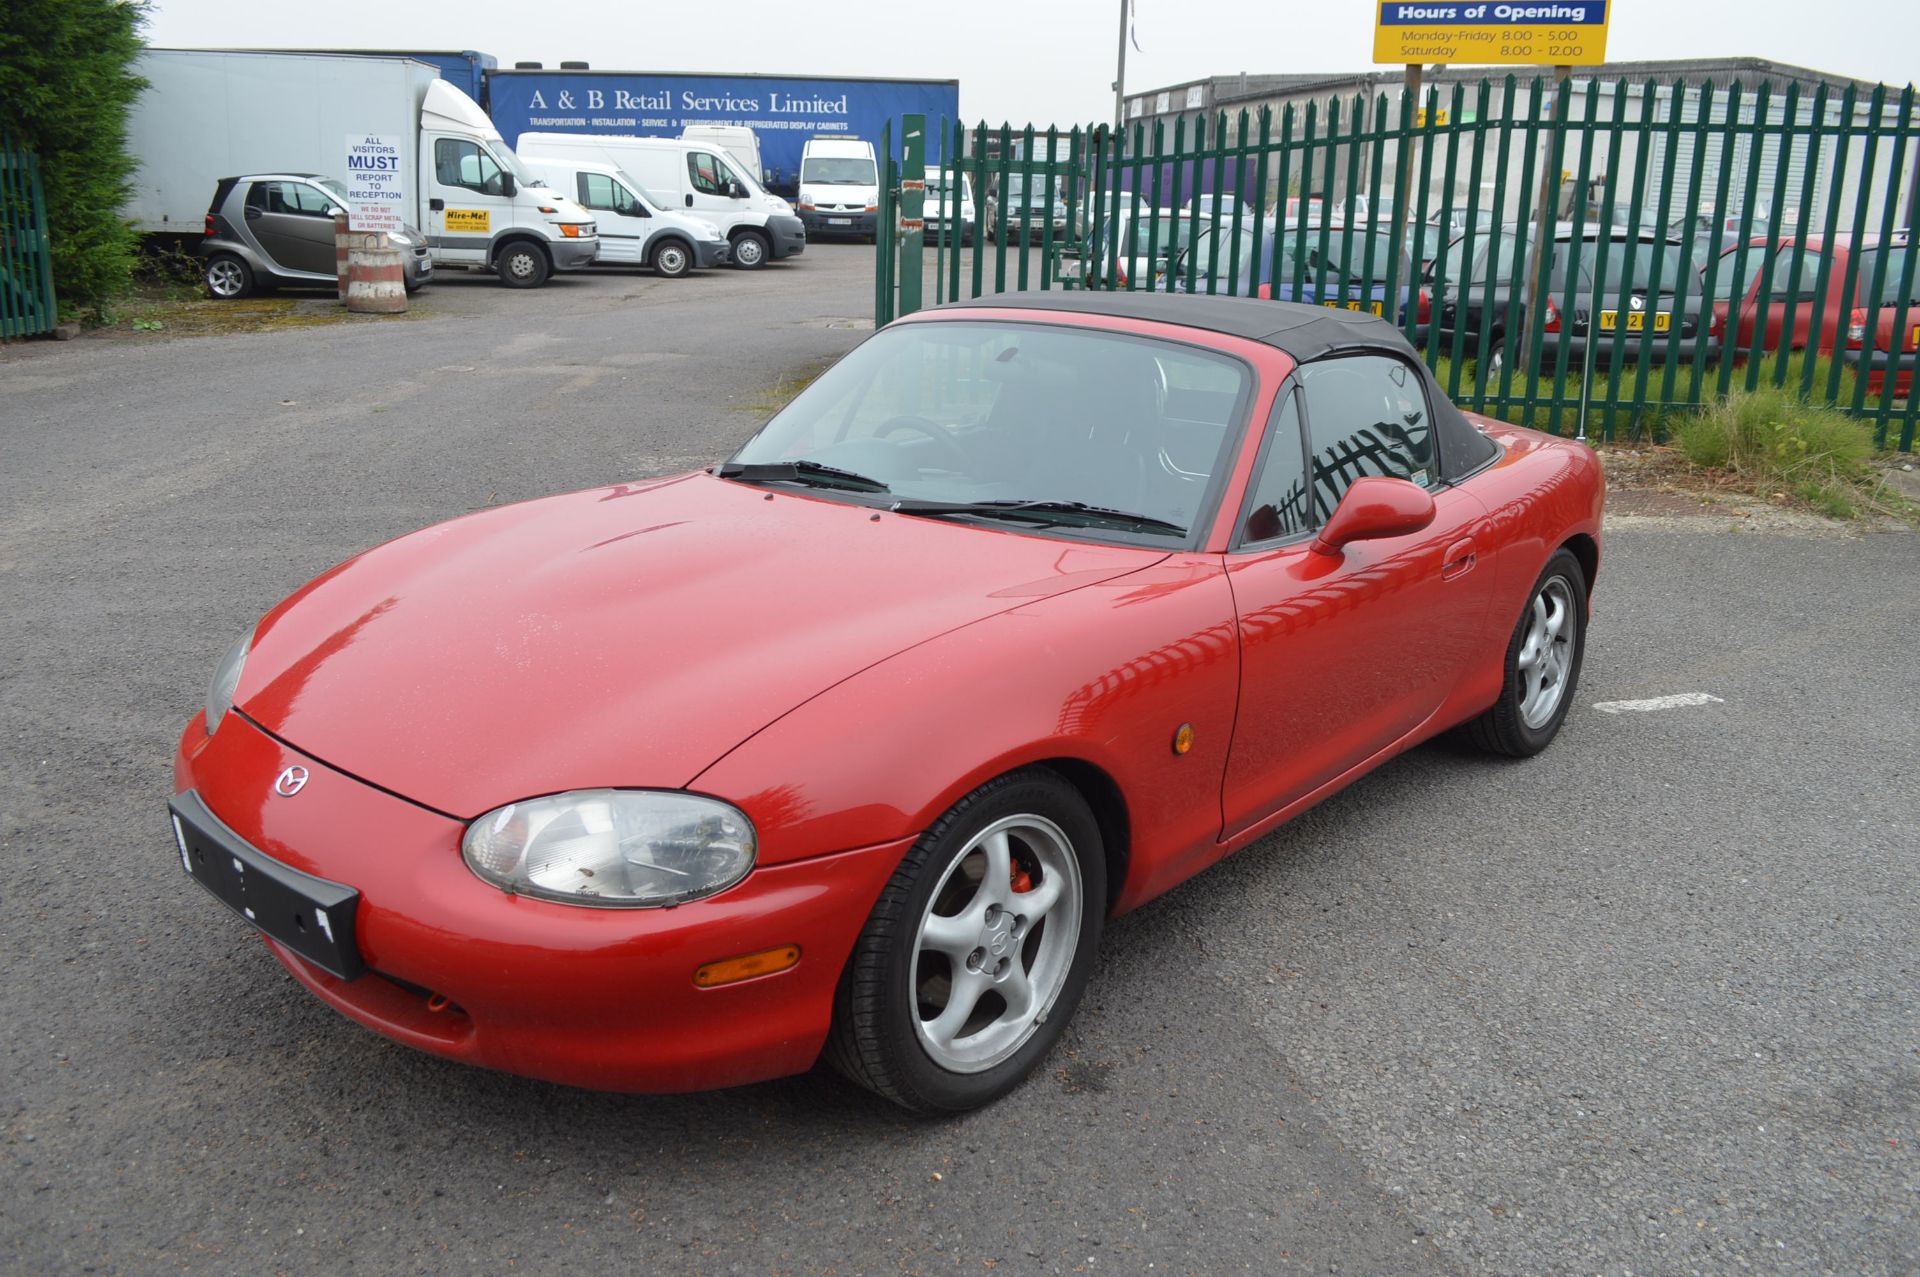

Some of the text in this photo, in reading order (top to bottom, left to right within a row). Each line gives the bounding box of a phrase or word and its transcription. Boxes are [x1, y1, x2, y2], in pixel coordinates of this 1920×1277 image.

[1398, 5, 1586, 22] Hours of Opening
[1401, 31, 1497, 43] Monday-Friday
[1502, 30, 1533, 41] 8.00
[1548, 30, 1578, 41] 5.00
[1401, 45, 1457, 58] Saturday
[1500, 46, 1533, 56] 8.00
[1549, 46, 1583, 57] 12.00
[529, 89, 848, 114] A & B Retail Services Limited
[529, 118, 586, 126] TRANSPORTATION
[592, 118, 636, 127] INSTALLATION
[642, 118, 668, 127] SERVICE
[744, 120, 788, 129] REFRIGERATED
[790, 121, 816, 130] DISPLAY
[817, 121, 849, 130] CABINETS
[365, 137, 382, 145] ALL
[352, 145, 396, 153] VISITORS
[348, 155, 399, 169] MUST
[356, 173, 393, 181] REPORT
[368, 182, 382, 190] TO
[349, 190, 402, 199] RECEPTION
[447, 211, 487, 220] Hire-Me!
